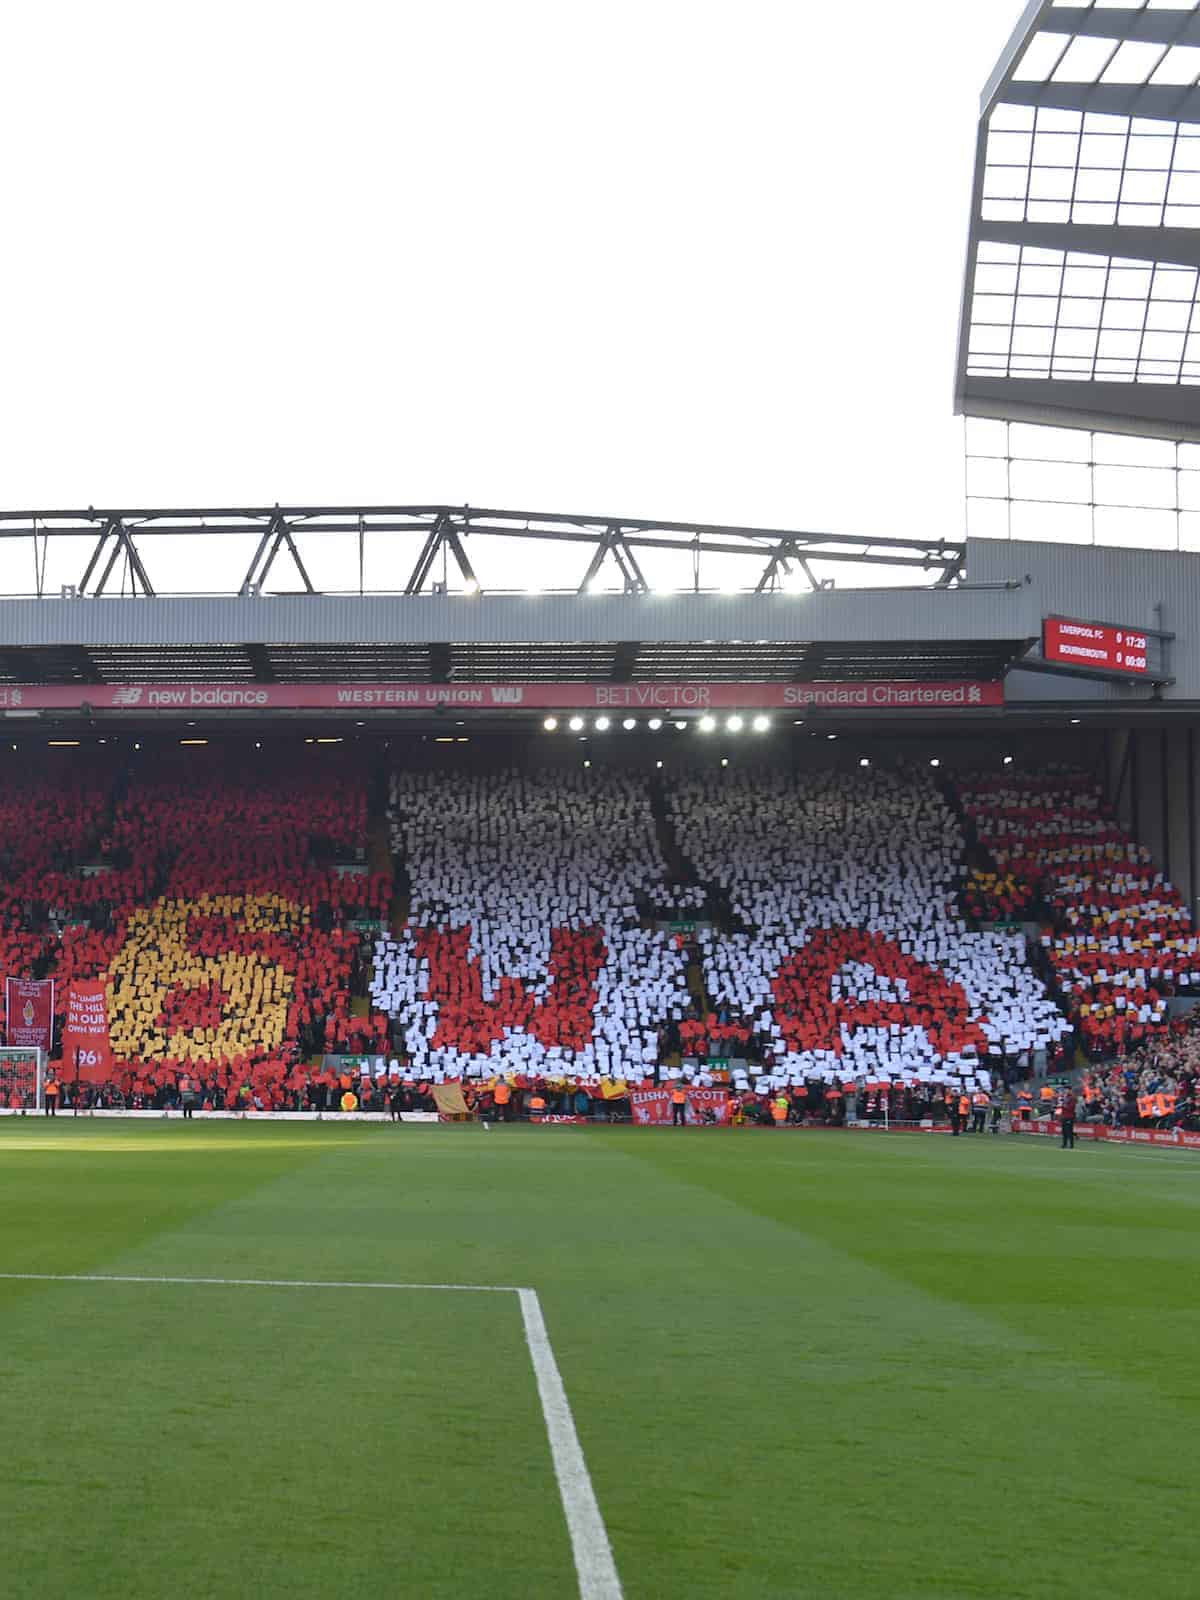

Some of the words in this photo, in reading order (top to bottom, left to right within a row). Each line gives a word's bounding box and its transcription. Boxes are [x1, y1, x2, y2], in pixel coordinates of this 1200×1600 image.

[1059, 625, 1094, 638] LIVERPOOL
[1116, 632, 1122, 643] 0
[1116, 652, 1122, 663] 0
[148, 690, 186, 704] new
[190, 687, 268, 704] balance
[337, 689, 418, 703] WESTERN
[426, 688, 483, 702] UNION
[783, 687, 868, 703] Standard
[872, 687, 965, 702] Chartered
[70, 1001, 84, 1010] THE
[85, 1003, 104, 1012] HILL
[69, 1012, 78, 1022] IN
[80, 1014, 105, 1024] OUR
[78, 1050, 97, 1065] 96
[632, 1091, 670, 1104] ELISHA
[688, 1090, 725, 1101] SCOTT
